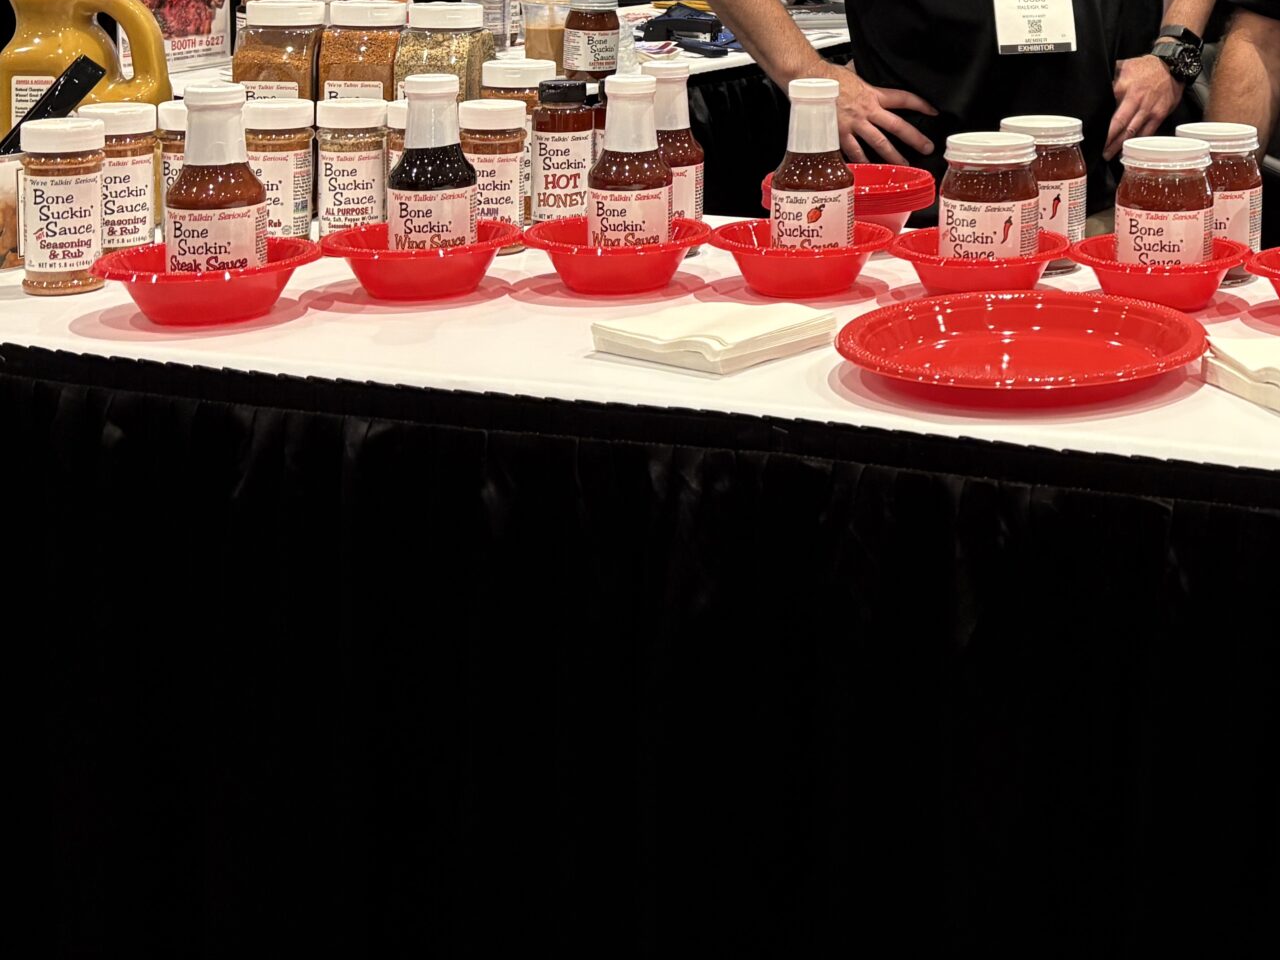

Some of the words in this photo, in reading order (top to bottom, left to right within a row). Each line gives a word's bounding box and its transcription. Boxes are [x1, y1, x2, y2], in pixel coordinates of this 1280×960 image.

[171, 38, 196, 51] BOOTH
[206, 35, 224, 46] 6227
[538, 143, 570, 156] Bone
[324, 162, 357, 177] Bone
[543, 156, 586, 171] Suckin'
[104, 174, 131, 184] one
[328, 177, 375, 191] Suckin'
[544, 173, 581, 189] HOT
[33, 189, 74, 205] Bone
[537, 191, 587, 208] HONEY
[39, 205, 94, 221] Suckin'
[399, 202, 432, 218] Bone
[596, 201, 627, 217] Bone
[774, 203, 802, 221] Bone
[404, 219, 452, 234] Suckin'
[601, 217, 645, 232] Suckin'
[946, 210, 976, 228] Bone
[107, 227, 118, 236] &
[120, 226, 140, 236] Rub
[173, 221, 209, 238] Bone
[777, 221, 822, 238] Suckin'
[949, 227, 997, 244] Suckin'
[1129, 219, 1164, 236] Bone
[40, 239, 92, 249] Seasoning
[178, 239, 231, 256] Suckin'
[430, 234, 466, 249] Sauce
[624, 234, 660, 246] Sauce
[1133, 236, 1184, 252] Suckin'
[49, 250, 60, 259] &
[62, 249, 84, 259] Rub
[953, 244, 995, 259] Sauce
[170, 255, 202, 272] Steak
[206, 256, 248, 271] Sauce
